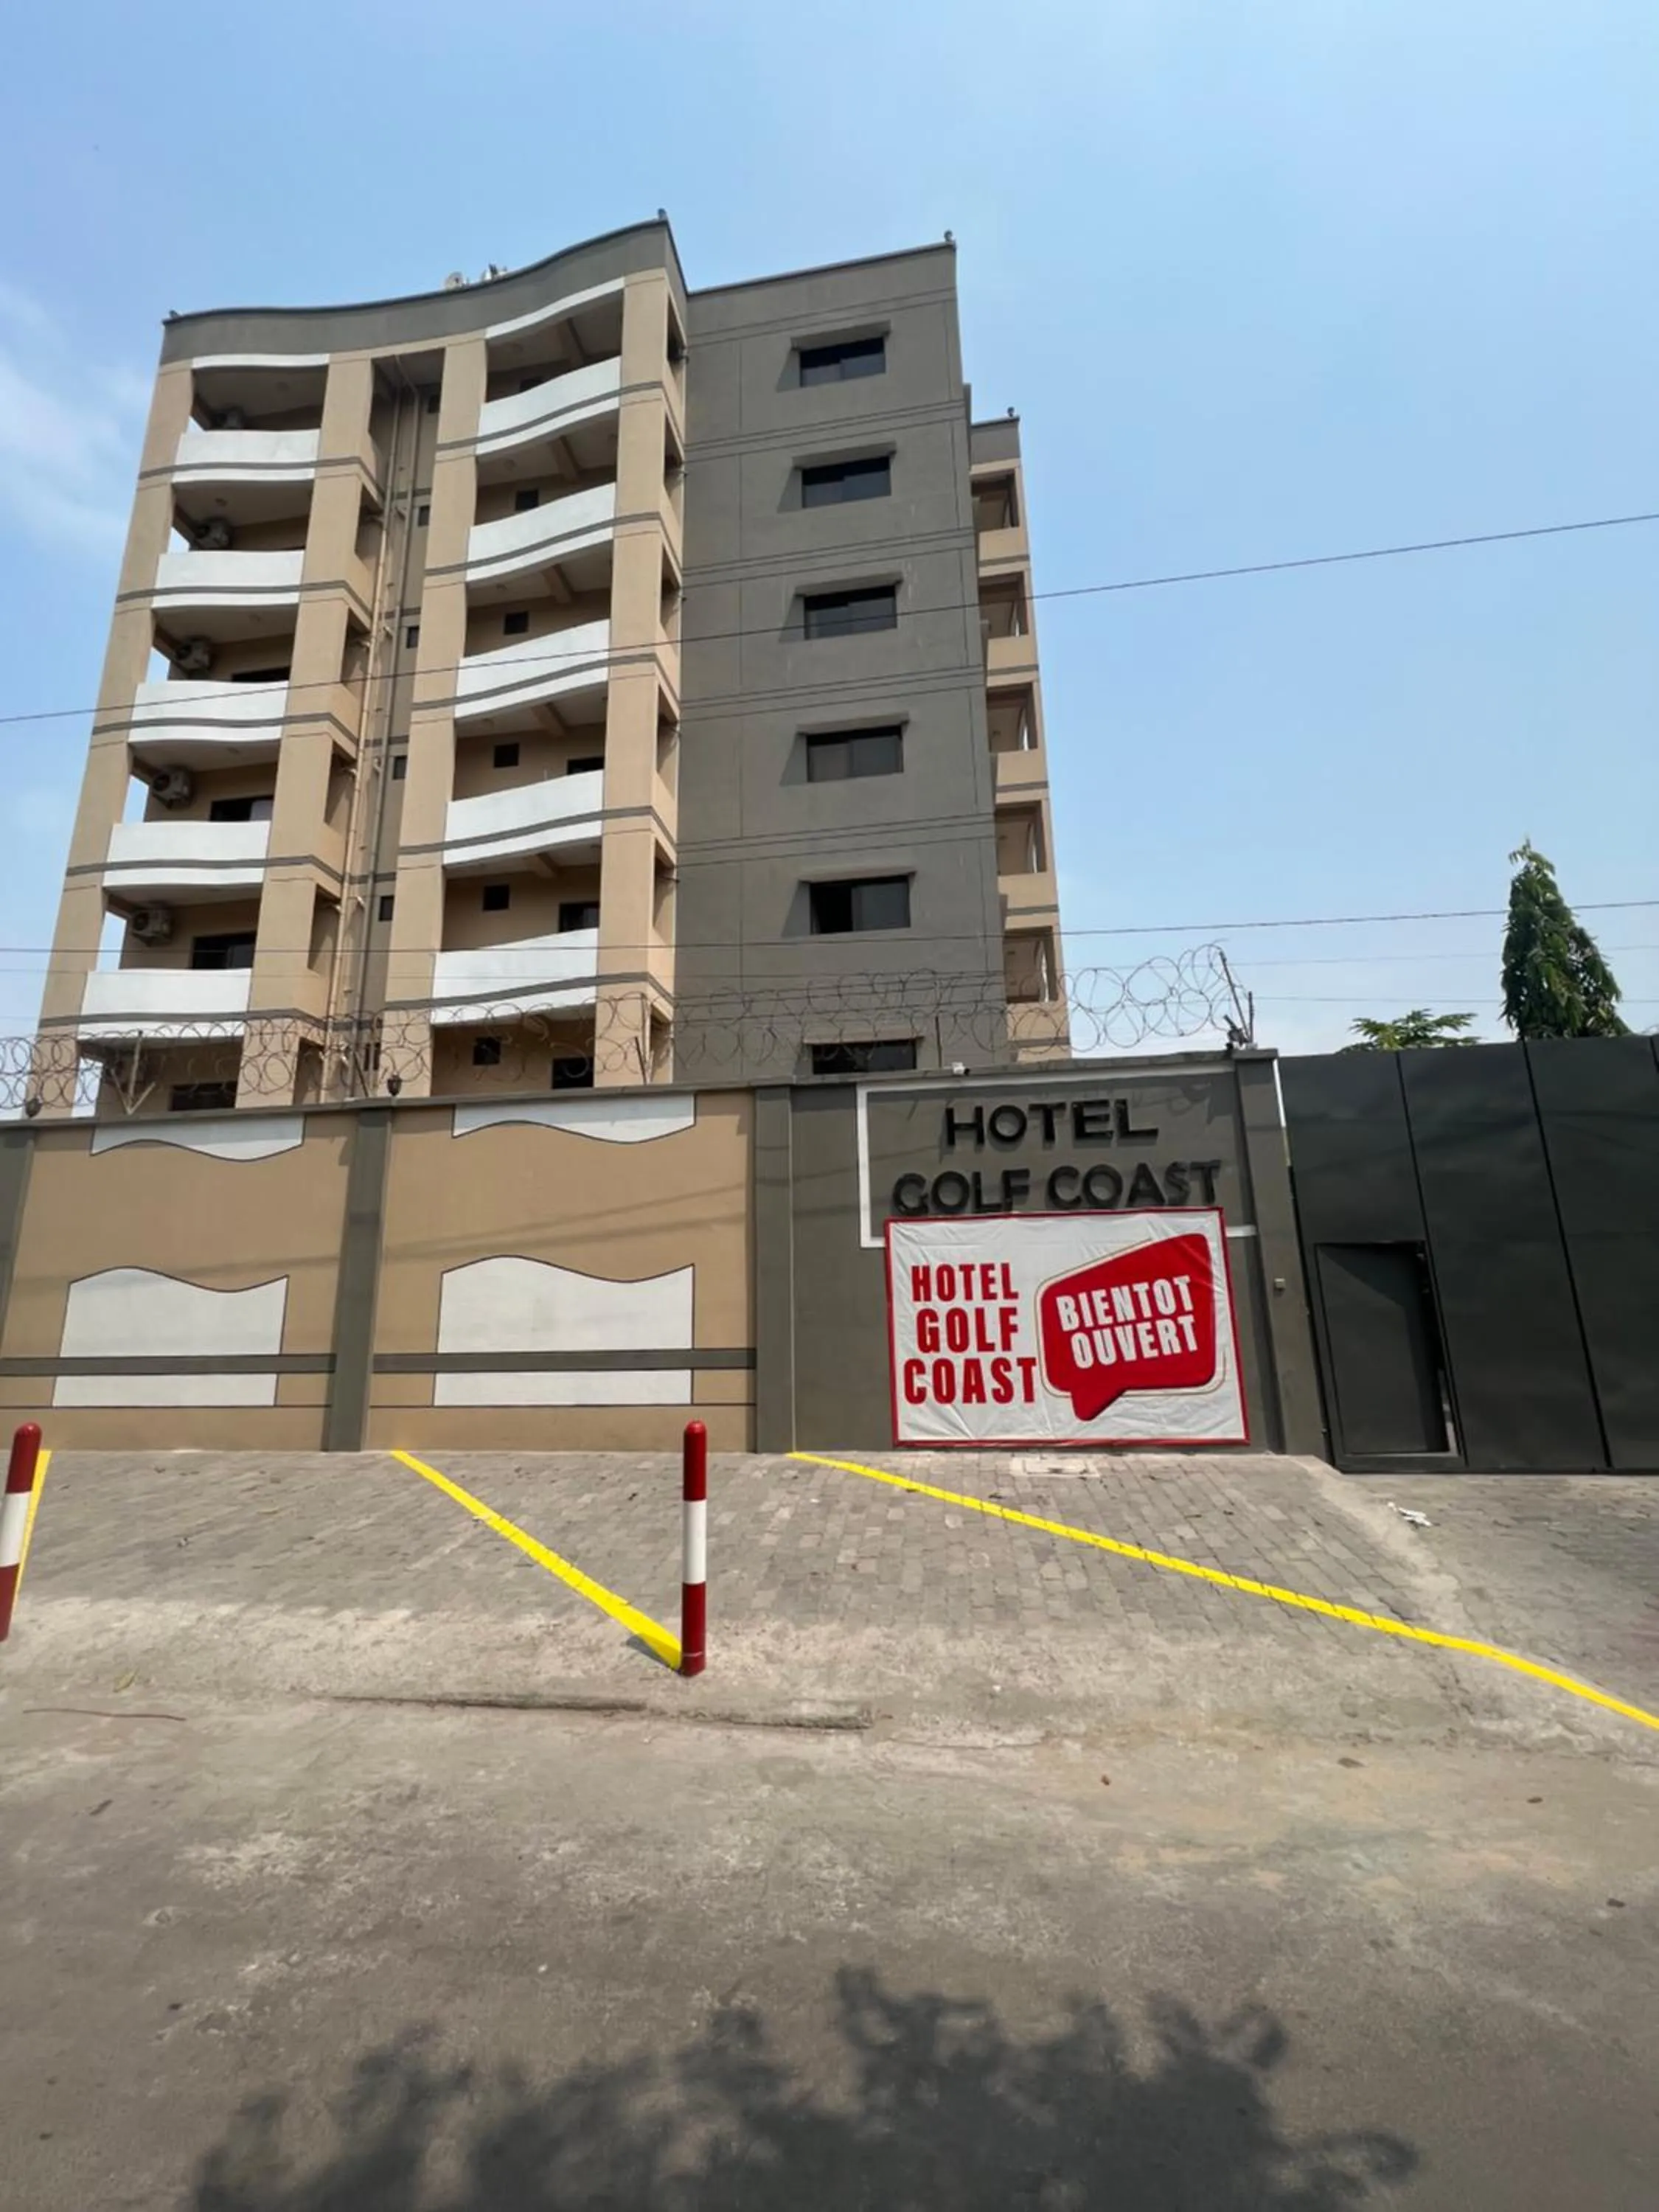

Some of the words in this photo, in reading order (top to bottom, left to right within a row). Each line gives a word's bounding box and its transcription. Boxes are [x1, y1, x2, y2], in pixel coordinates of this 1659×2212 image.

[945, 1098, 1158, 1146] HOTEL
[892, 1169, 1030, 1216] GOLF
[1046, 1160, 1221, 1209] COAST
[911, 1262, 1019, 1301] HOTEL
[1056, 1276, 1195, 1332] BIENTOT
[917, 1307, 1018, 1353] GOLF
[1071, 1315, 1198, 1369] OUVERT
[903, 1357, 1037, 1405] COAST
